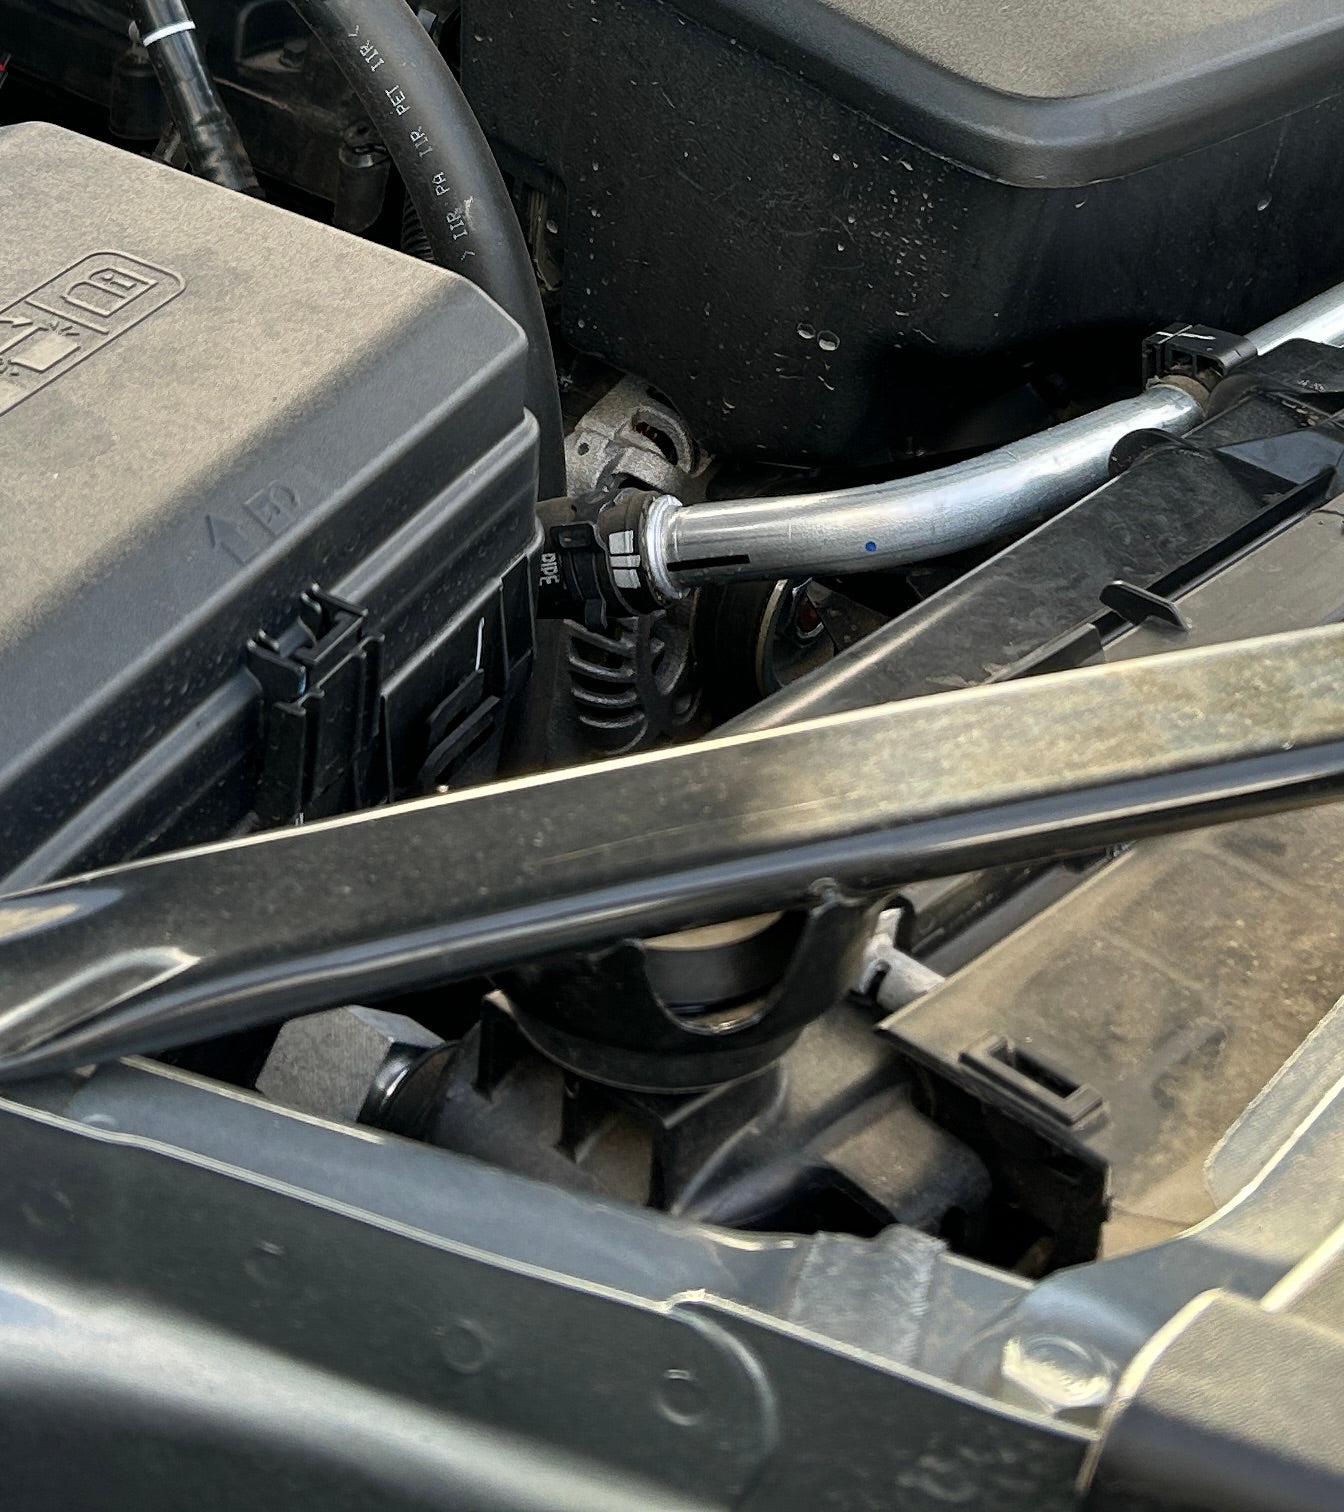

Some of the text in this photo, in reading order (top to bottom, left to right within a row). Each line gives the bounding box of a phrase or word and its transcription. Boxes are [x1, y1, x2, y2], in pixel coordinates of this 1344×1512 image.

[359, 39, 385, 72] IIR
[385, 85, 411, 116] PET
[409, 125, 433, 158] IIR
[431, 171, 451, 197] PA
